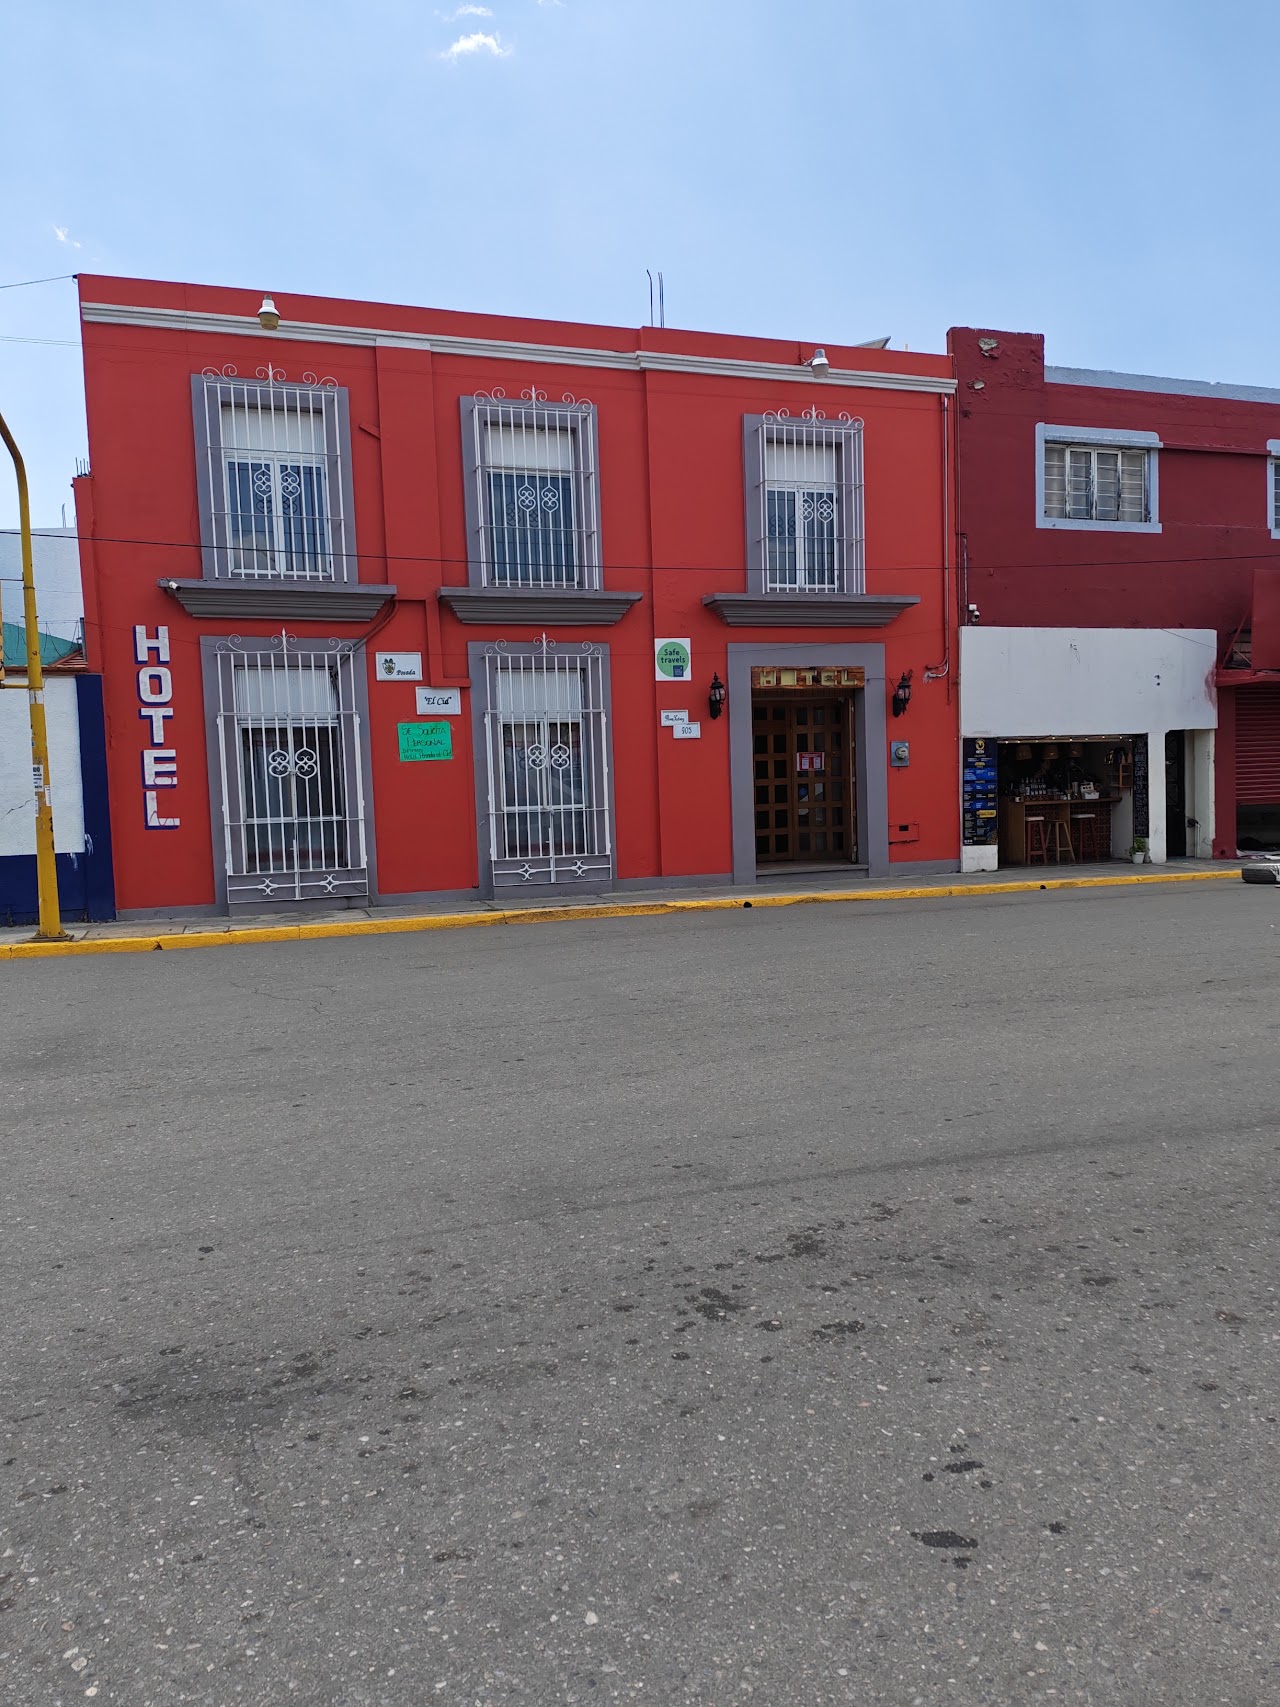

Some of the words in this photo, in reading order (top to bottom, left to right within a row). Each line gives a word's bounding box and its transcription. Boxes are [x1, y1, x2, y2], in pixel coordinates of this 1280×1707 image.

[664, 648, 680, 656] Safe
[660, 655, 686, 664] travels
[759, 669, 857, 686] HOTEL
[133, 625, 181, 830] HOTEL
[406, 736, 447, 747] PERSONAL
